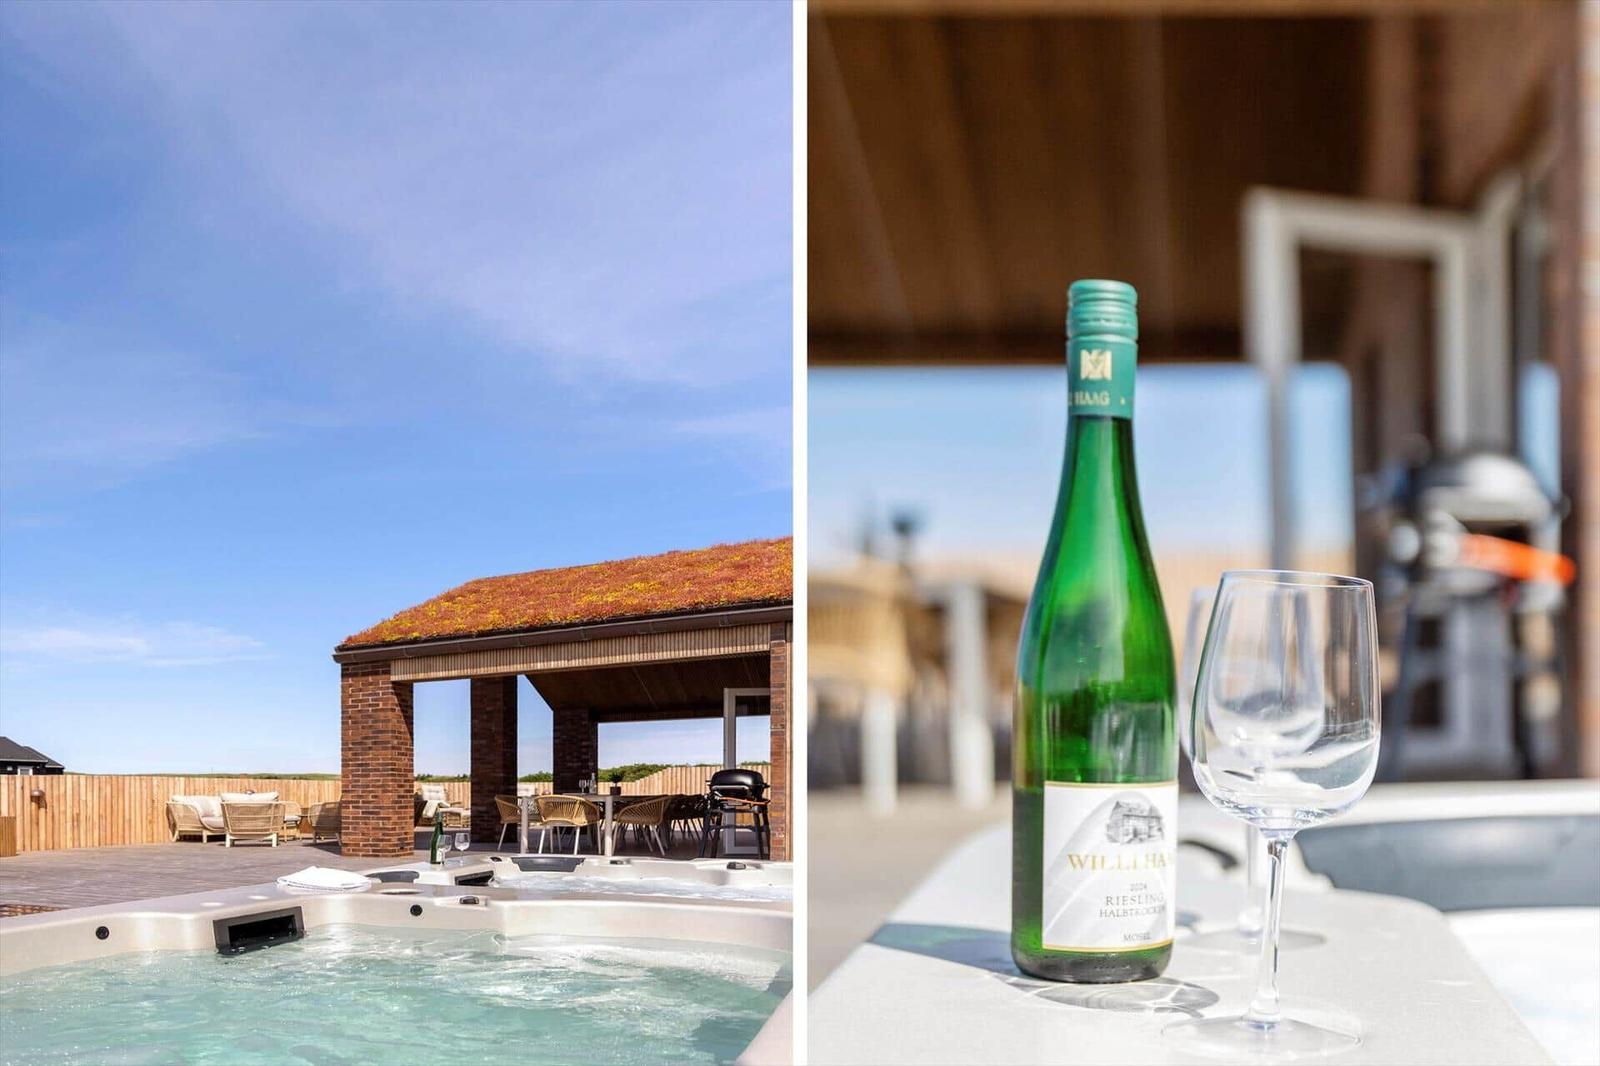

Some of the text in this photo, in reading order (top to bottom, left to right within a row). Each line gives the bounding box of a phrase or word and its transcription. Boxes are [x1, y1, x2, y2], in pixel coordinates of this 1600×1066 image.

[1074, 390, 1110, 406] HAAG
[1145, 853, 1170, 869] HA
[1106, 893, 1164, 906] RIESLING
[1123, 932, 1152, 943] MOSEL
